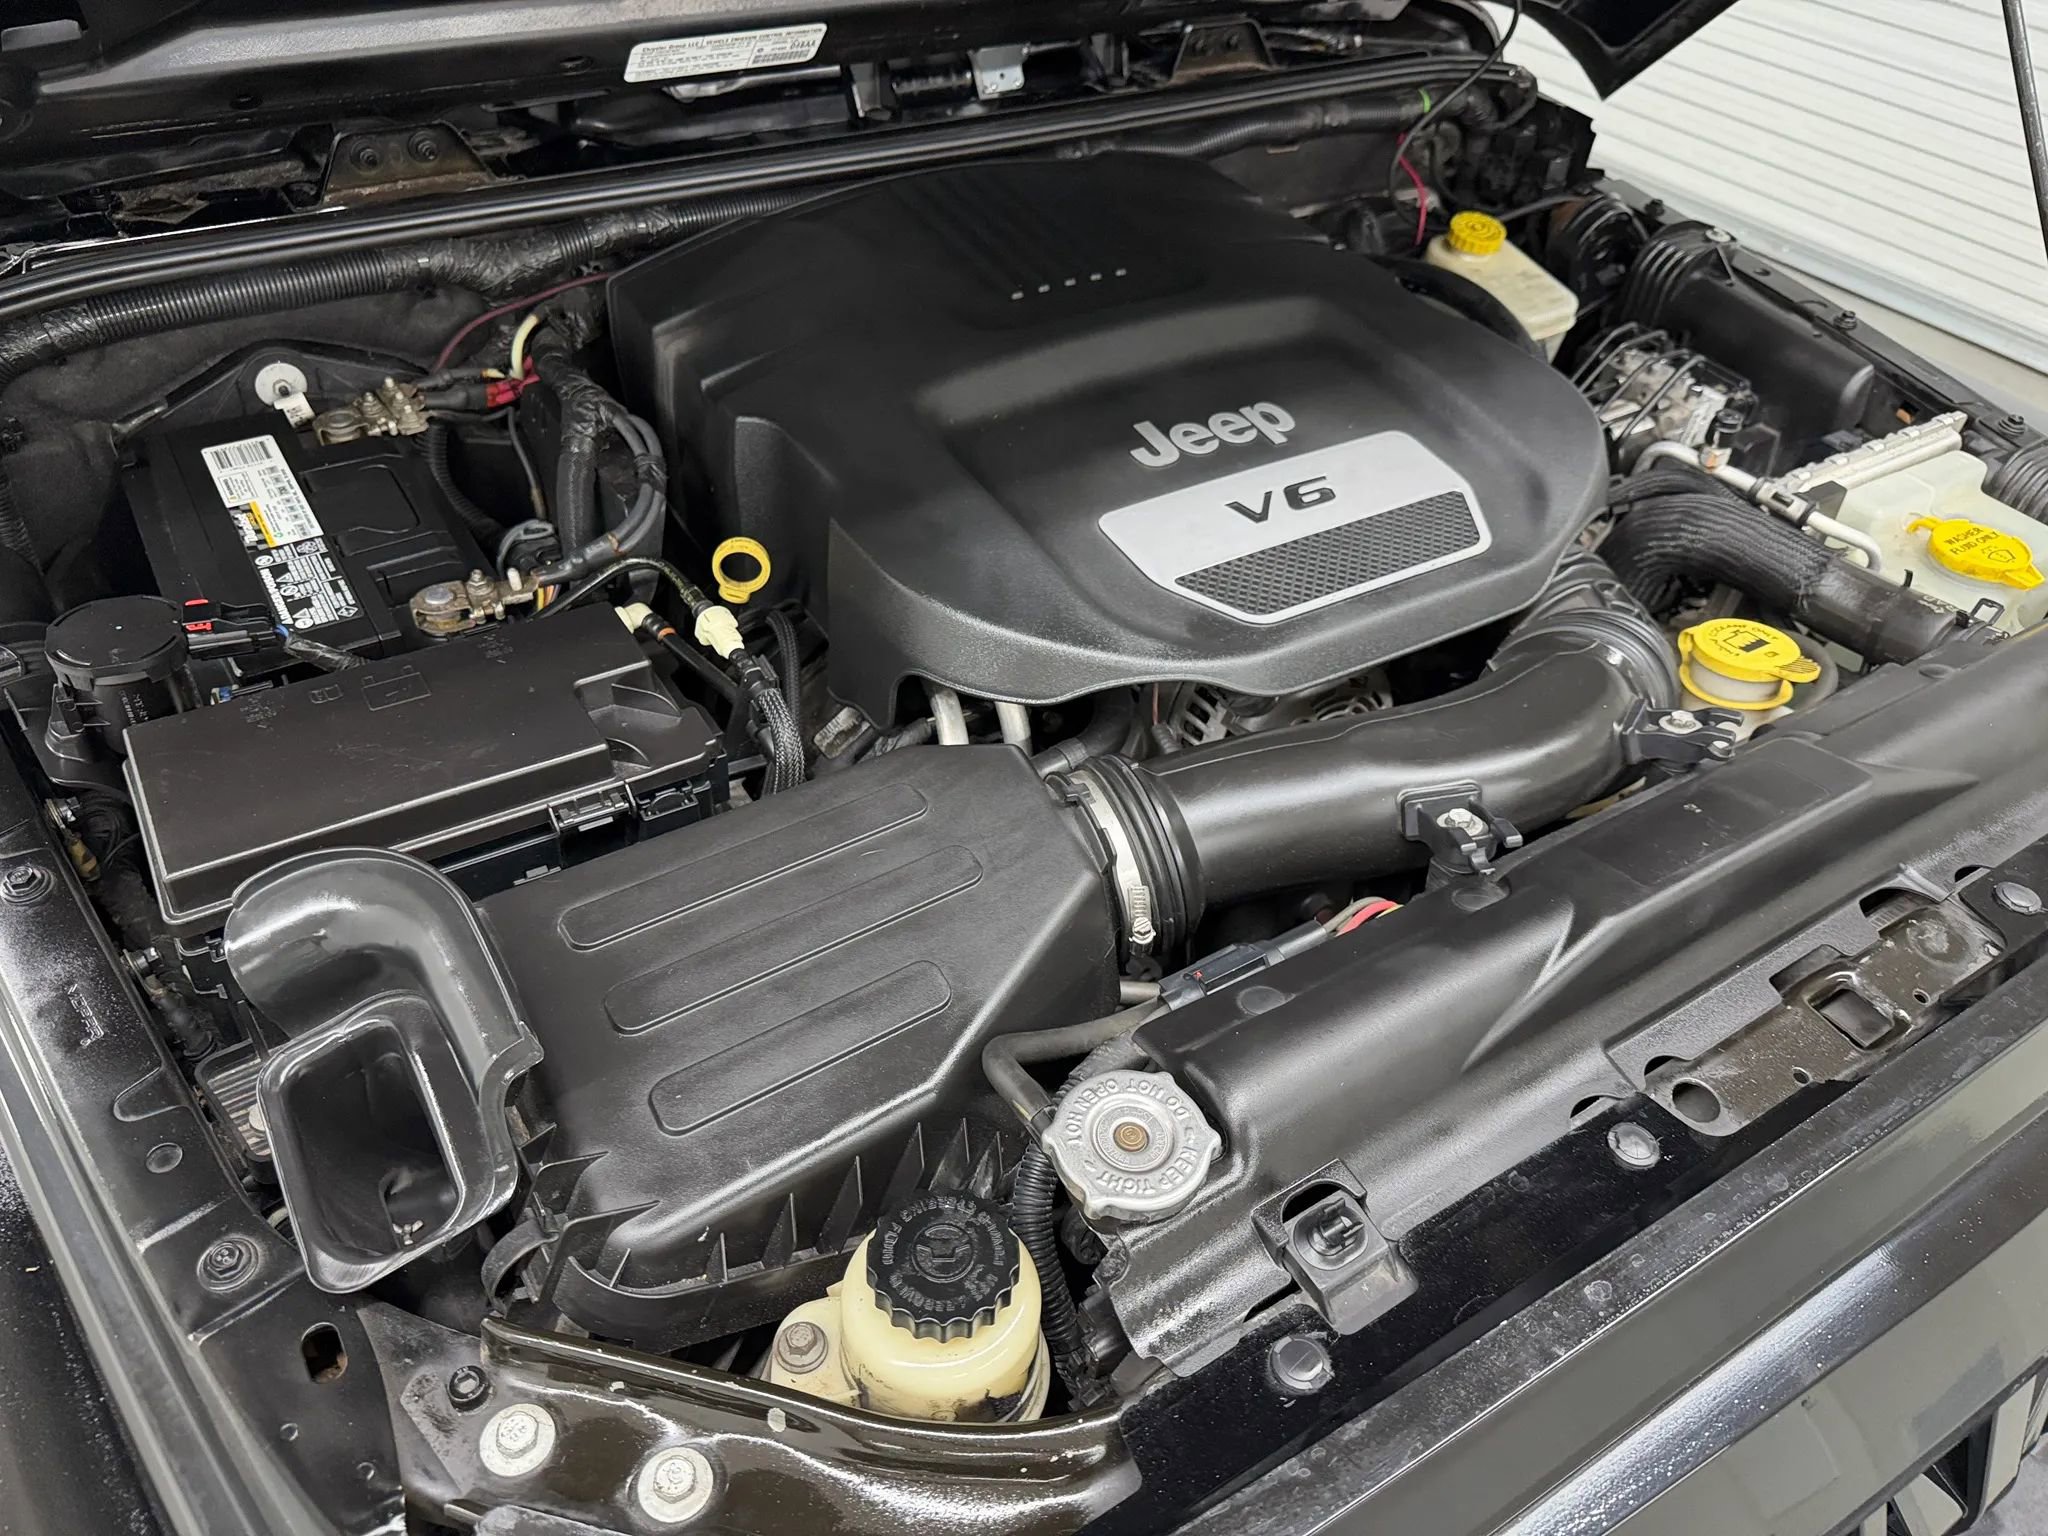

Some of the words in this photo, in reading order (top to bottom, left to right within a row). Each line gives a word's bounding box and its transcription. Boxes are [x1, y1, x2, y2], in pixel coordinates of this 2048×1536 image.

[1129, 402, 1296, 467] Jeep
[1224, 476, 1336, 514] V6
[1944, 527, 1984, 546] WASHER
[1949, 541, 1978, 555] FLUID
[1975, 531, 2001, 545] ONLY
[1073, 1077, 1120, 1110] OPEN
[1125, 1078, 1166, 1100] NOT
[1167, 1095, 1190, 1121] DO
[1065, 1109, 1083, 1147] HOT
[1159, 1145, 1199, 1189] KEEP
[1096, 1169, 1157, 1196] TIGHT
